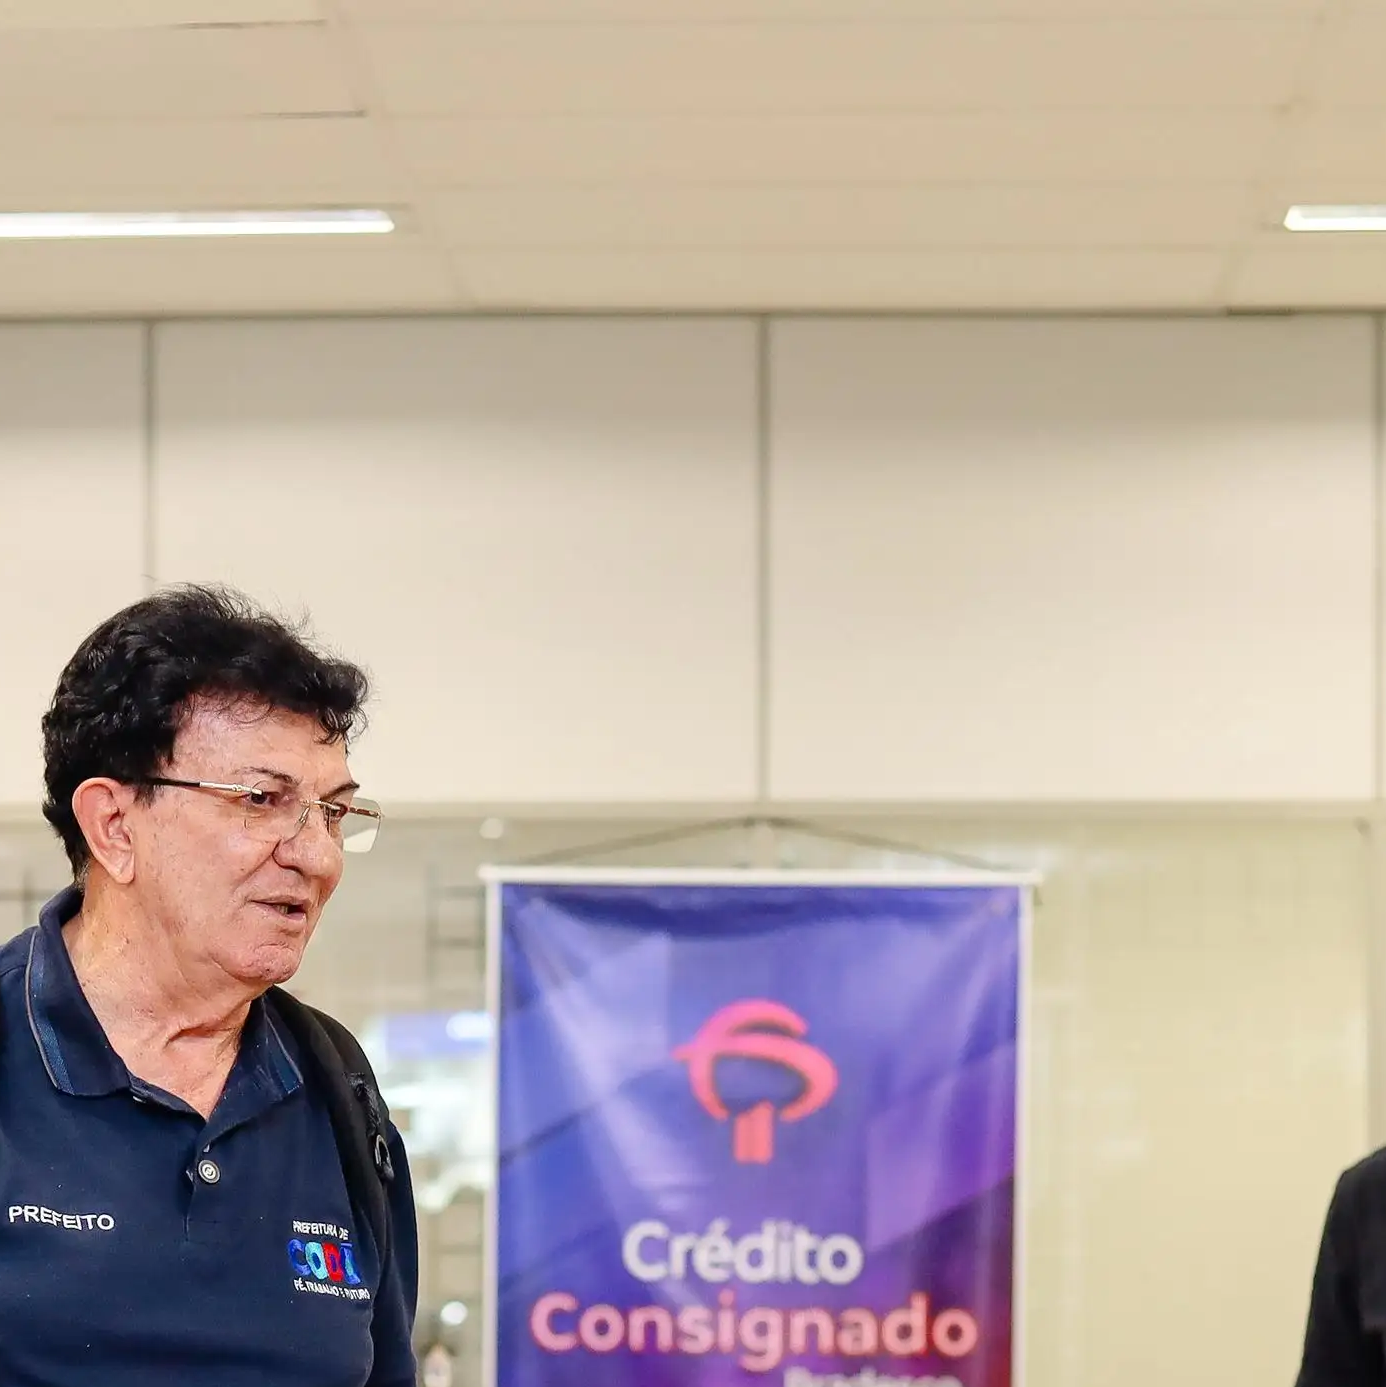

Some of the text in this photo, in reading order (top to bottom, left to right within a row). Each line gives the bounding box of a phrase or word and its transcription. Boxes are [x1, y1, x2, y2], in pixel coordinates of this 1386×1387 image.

[8, 1205, 115, 1231] PREFEITO
[293, 1220, 338, 1238] PREFEITURA
[622, 1217, 864, 1285] Crédito
[530, 1289, 978, 1373] Consignado
